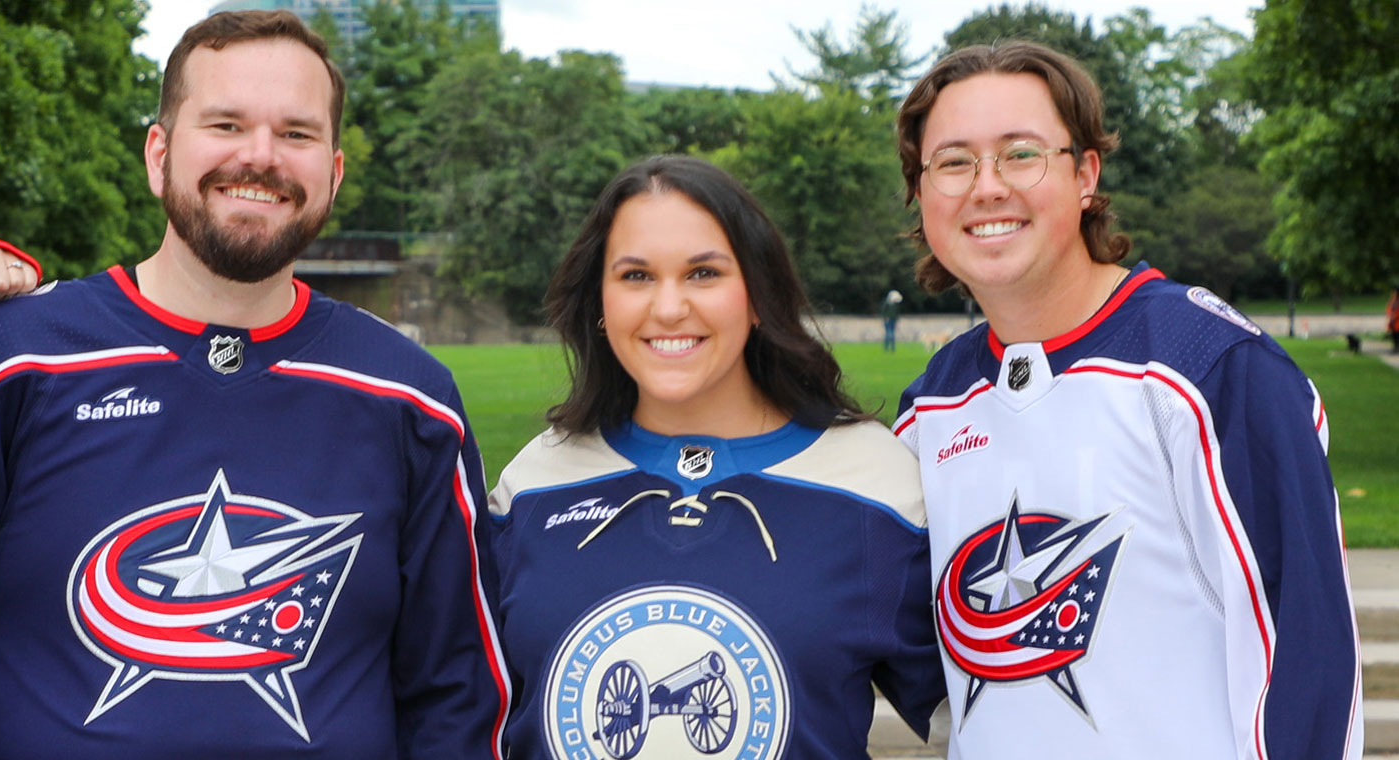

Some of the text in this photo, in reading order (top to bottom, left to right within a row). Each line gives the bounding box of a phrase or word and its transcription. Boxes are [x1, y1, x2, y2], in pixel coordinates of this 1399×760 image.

[76, 397, 161, 421] Safelite
[936, 433, 989, 464] Safelite
[544, 504, 620, 530] Safelite
[561, 603, 772, 760] COLUMBUS BLUE JACKET
